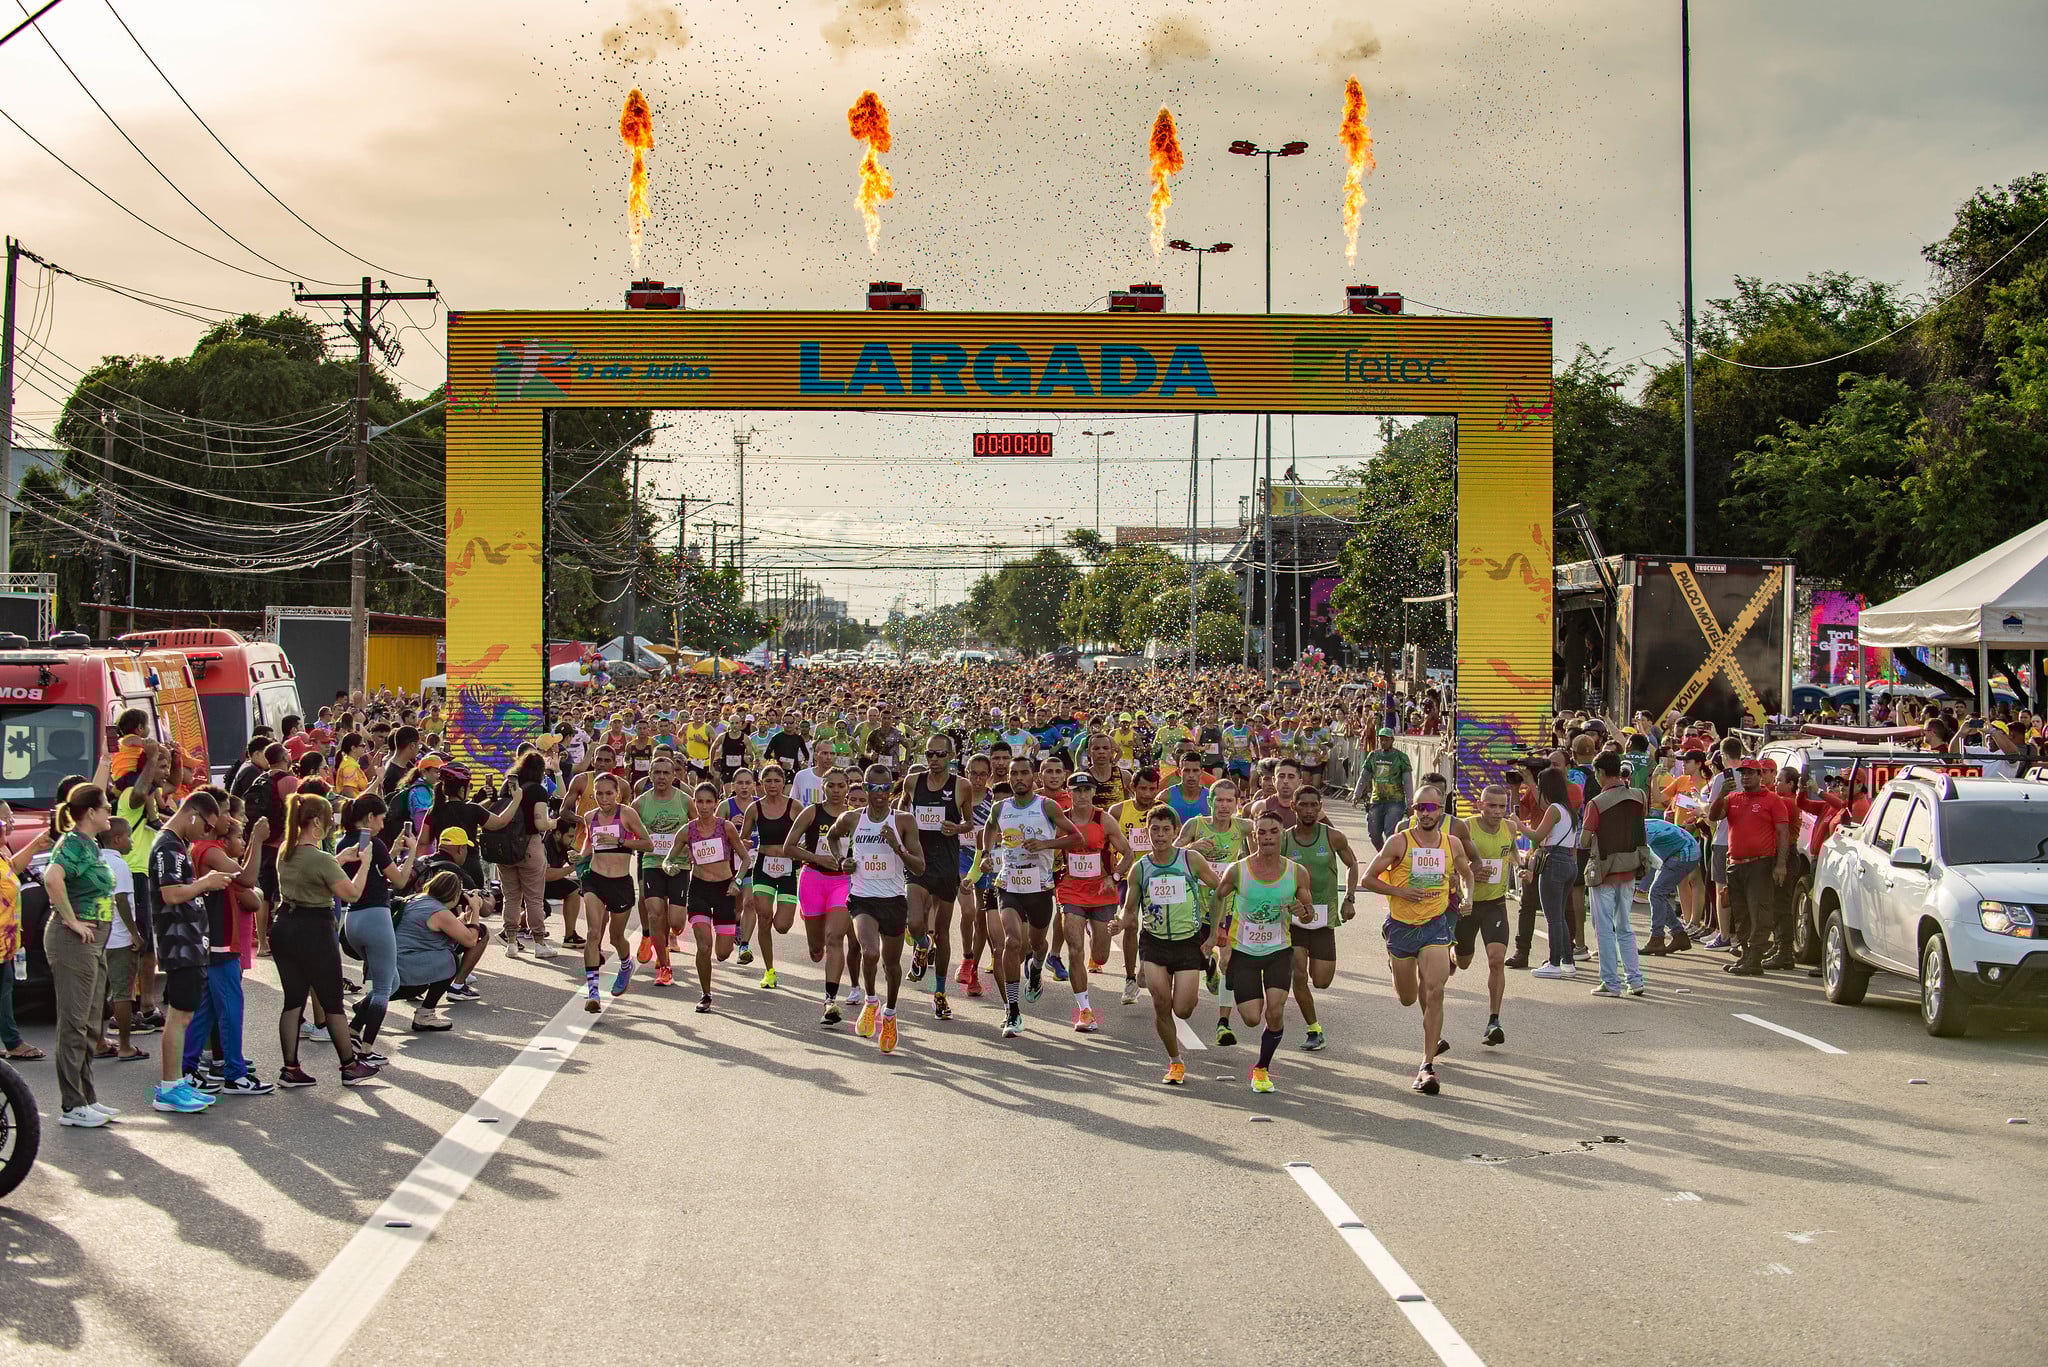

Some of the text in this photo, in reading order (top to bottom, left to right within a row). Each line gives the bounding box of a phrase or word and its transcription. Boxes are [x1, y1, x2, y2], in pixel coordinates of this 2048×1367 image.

[800, 342, 1218, 397] LARGADA
[1344, 348, 1448, 383] fetec
[578, 362, 711, 380] 9 de Julho
[975, 434, 1051, 455] 00:00:00
[1676, 570, 1721, 647] PALCO MÓVEL
[1826, 630, 1854, 640] Toni
[920, 813, 940, 823] 0023
[654, 840, 672, 849] 2505
[696, 846, 716, 857] 0020
[864, 861, 887, 871] 0038
[1073, 861, 1093, 871] 1074
[1417, 856, 1440, 868] 0004
[767, 863, 785, 873] 1469
[1011, 876, 1032, 886] 0036
[1154, 885, 1177, 896] 2321
[1249, 931, 1272, 941] 2269
